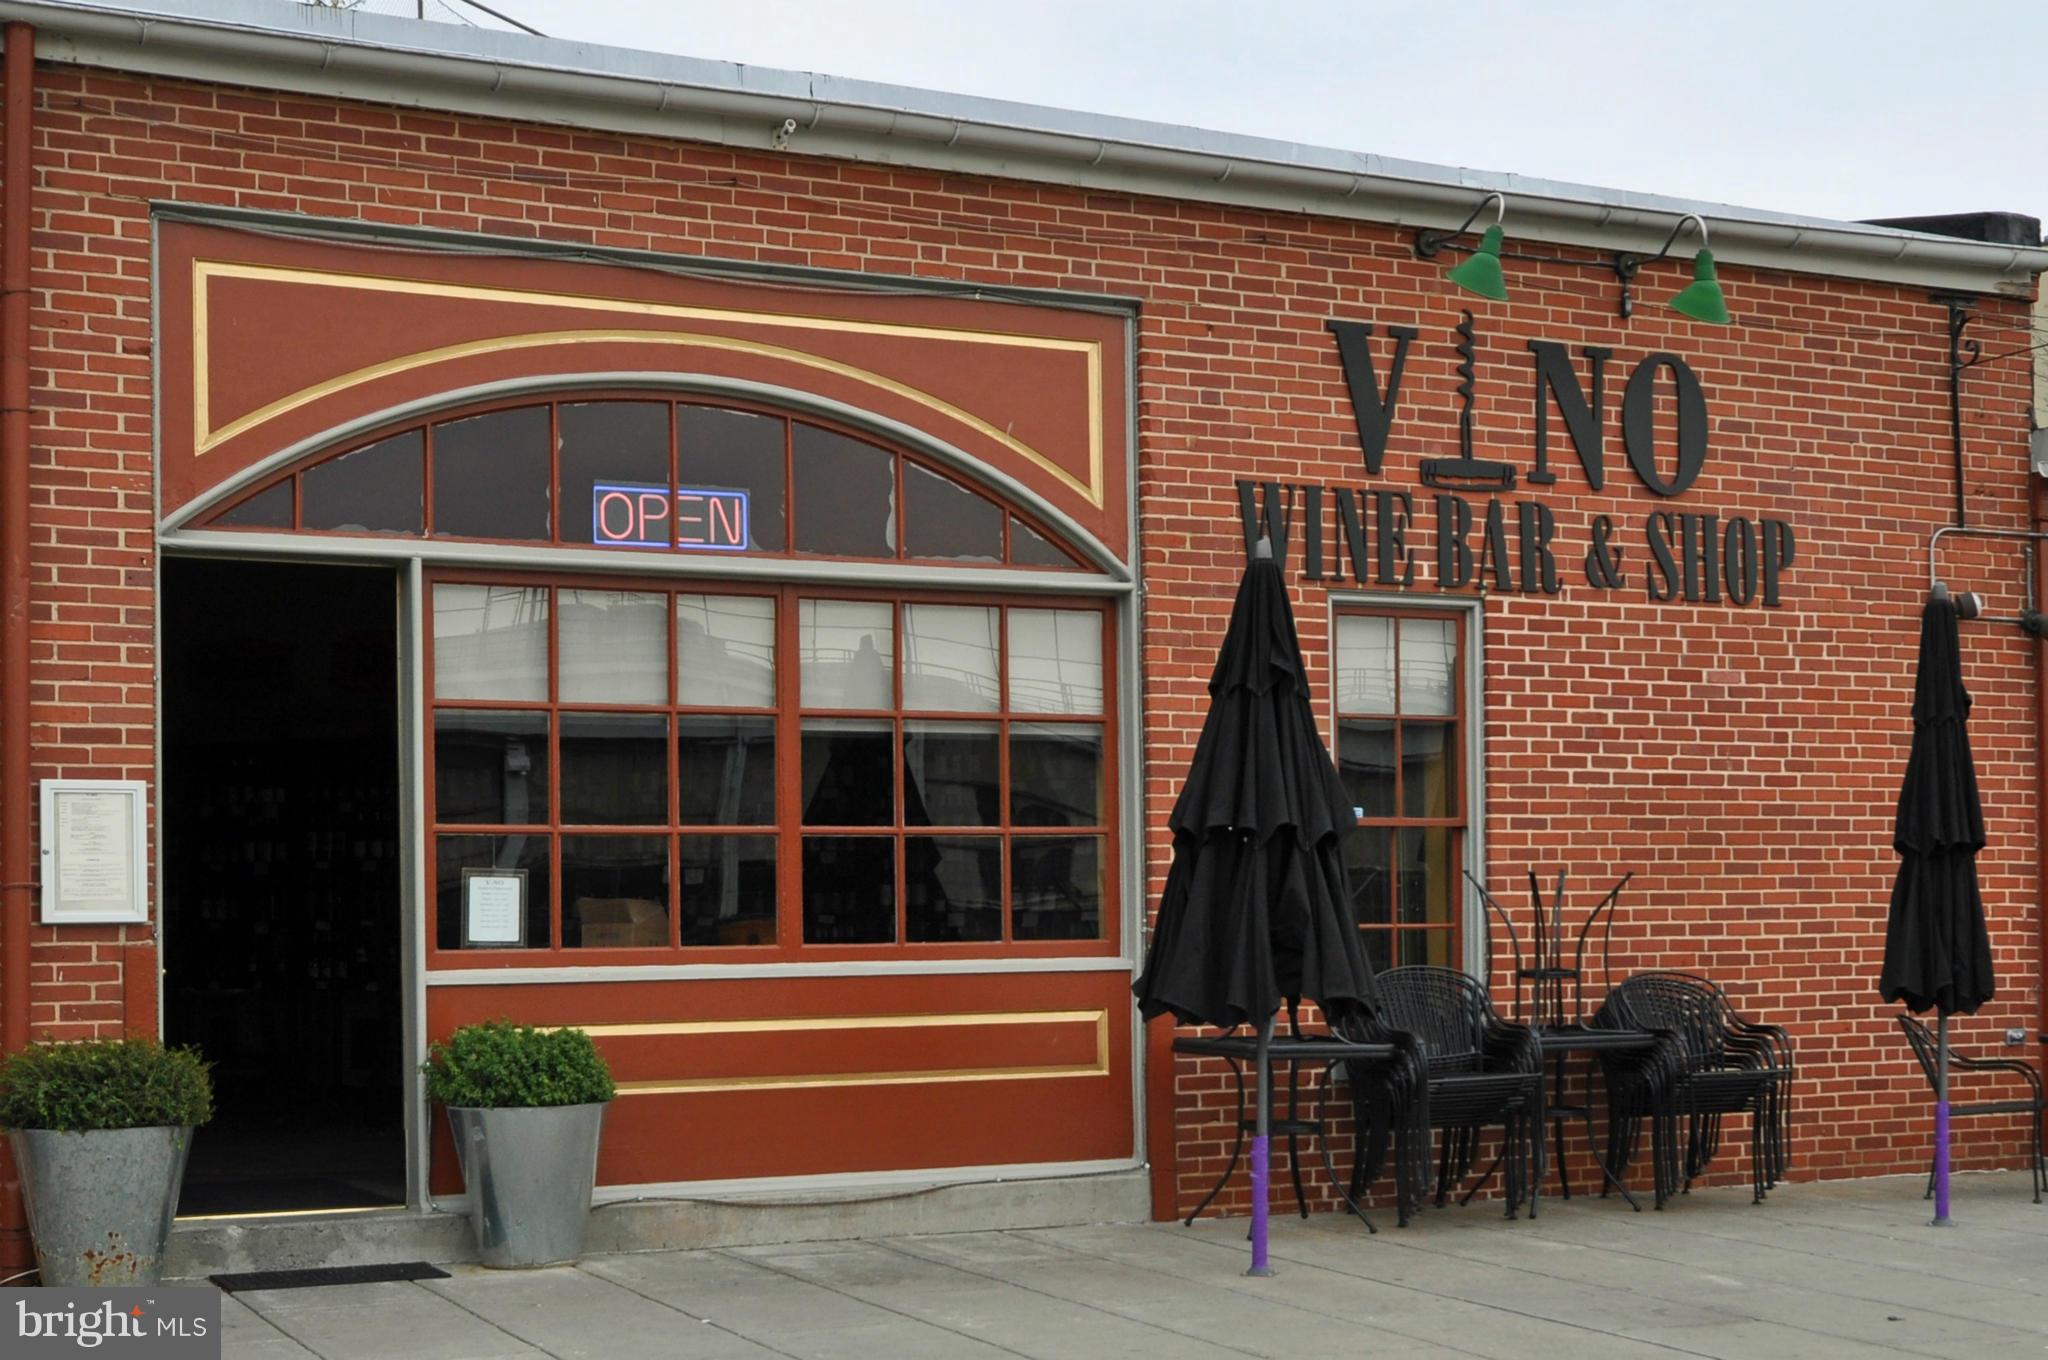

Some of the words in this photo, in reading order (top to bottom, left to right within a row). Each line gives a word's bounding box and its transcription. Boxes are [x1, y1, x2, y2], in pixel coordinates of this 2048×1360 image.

[600, 492, 740, 544] OPEN
[1234, 480, 1414, 586] WINE
[1432, 493, 1563, 594] BAR
[1585, 513, 1626, 589] &
[1646, 510, 1795, 607] SHOP
